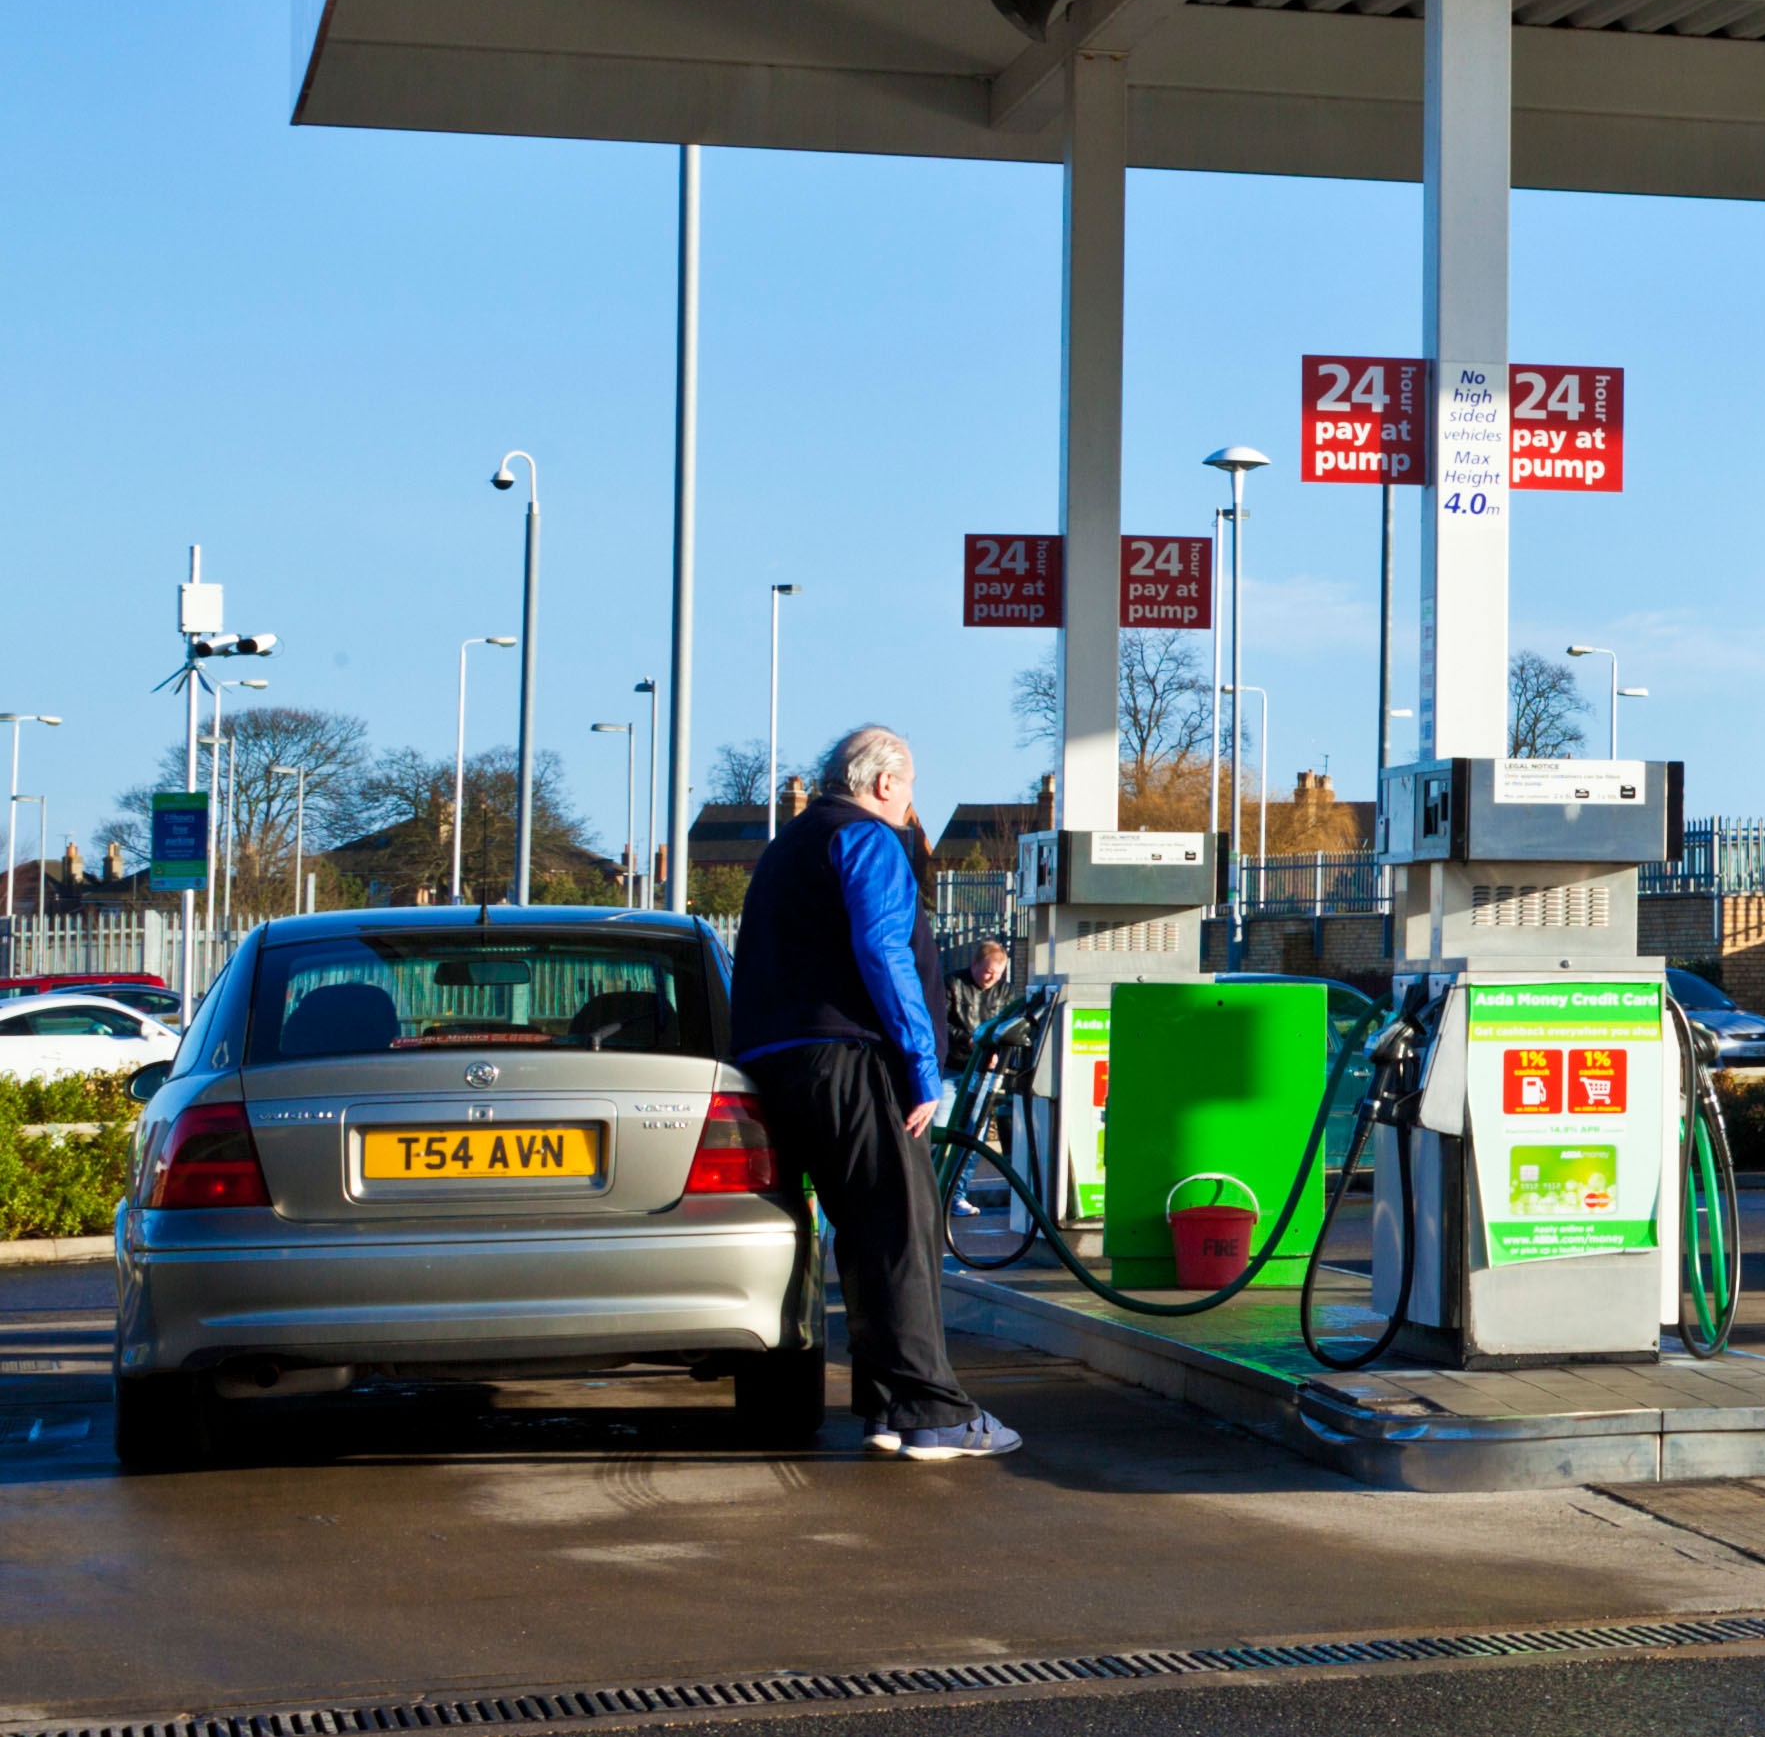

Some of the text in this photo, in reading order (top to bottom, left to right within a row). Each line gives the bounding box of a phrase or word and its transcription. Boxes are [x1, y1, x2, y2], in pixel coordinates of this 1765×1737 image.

[1460, 370, 1485, 385] No
[1316, 363, 1390, 413] 24
[1401, 366, 1416, 414] hour
[1453, 389, 1492, 406] high
[1513, 372, 1585, 421] 24
[1595, 375, 1611, 423] hour
[1449, 409, 1496, 423] sided
[1315, 420, 1411, 446] pay at
[1443, 429, 1502, 442] vehicles
[1512, 428, 1606, 453] pay at
[1315, 450, 1410, 477] pump
[1454, 451, 1491, 465] Max
[1444, 470, 1500, 488] Height
[1512, 457, 1606, 485] pump
[974, 540, 1029, 575] 24
[1036, 541, 1049, 576] hour
[1130, 541, 1183, 577] 24
[1190, 542, 1202, 577] hour
[973, 580, 1045, 599] pay at
[1128, 581, 1199, 601] pay at
[973, 603, 1045, 622] pump
[1128, 604, 1198, 623] pump
[1475, 992, 1659, 1008] Asda Money Credit Card
[1074, 1020, 1104, 1030] Asda
[1475, 1026, 1657, 1037] Get cashback everywhere you shop
[1520, 1051, 1547, 1067] 1%
[1584, 1051, 1611, 1067] 1%
[398, 1134, 564, 1171] T54 AVN
[1203, 1239, 1240, 1257] FIRE
